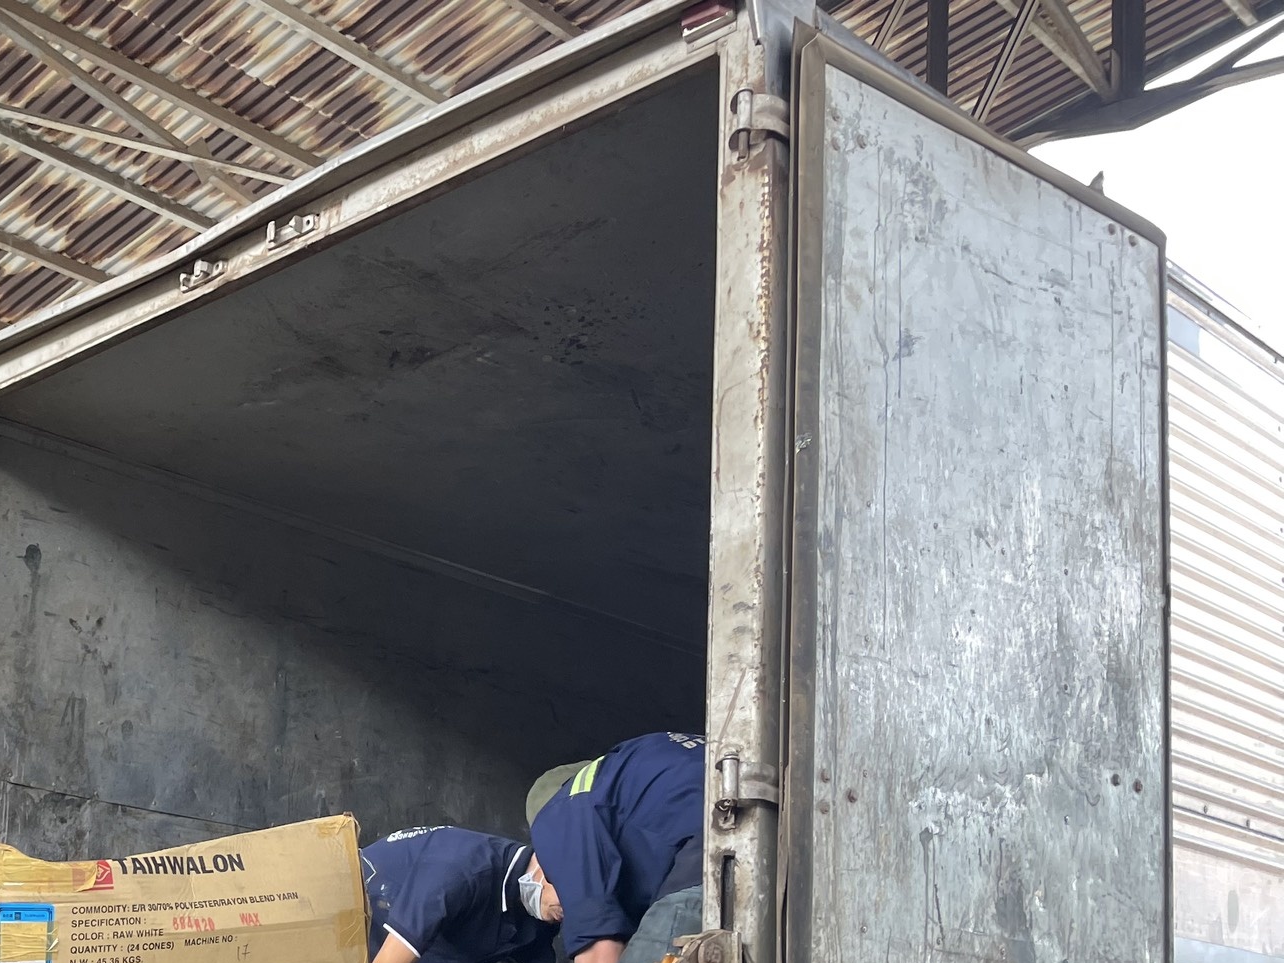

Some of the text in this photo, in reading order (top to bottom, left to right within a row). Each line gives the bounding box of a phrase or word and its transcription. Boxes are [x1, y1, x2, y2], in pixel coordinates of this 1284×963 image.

[113, 853, 245, 875] TAIHWALON
[72, 892, 299, 914] COMMODITY: E/R 30/70% POLYESTER/RAYON BLEND YARN
[239, 912, 261, 927] WAX
[112, 930, 133, 939] RAW
[136, 928, 164, 938] WHITE
[142, 941, 175, 951] CONES)
[184, 935, 220, 946] MACHINE
